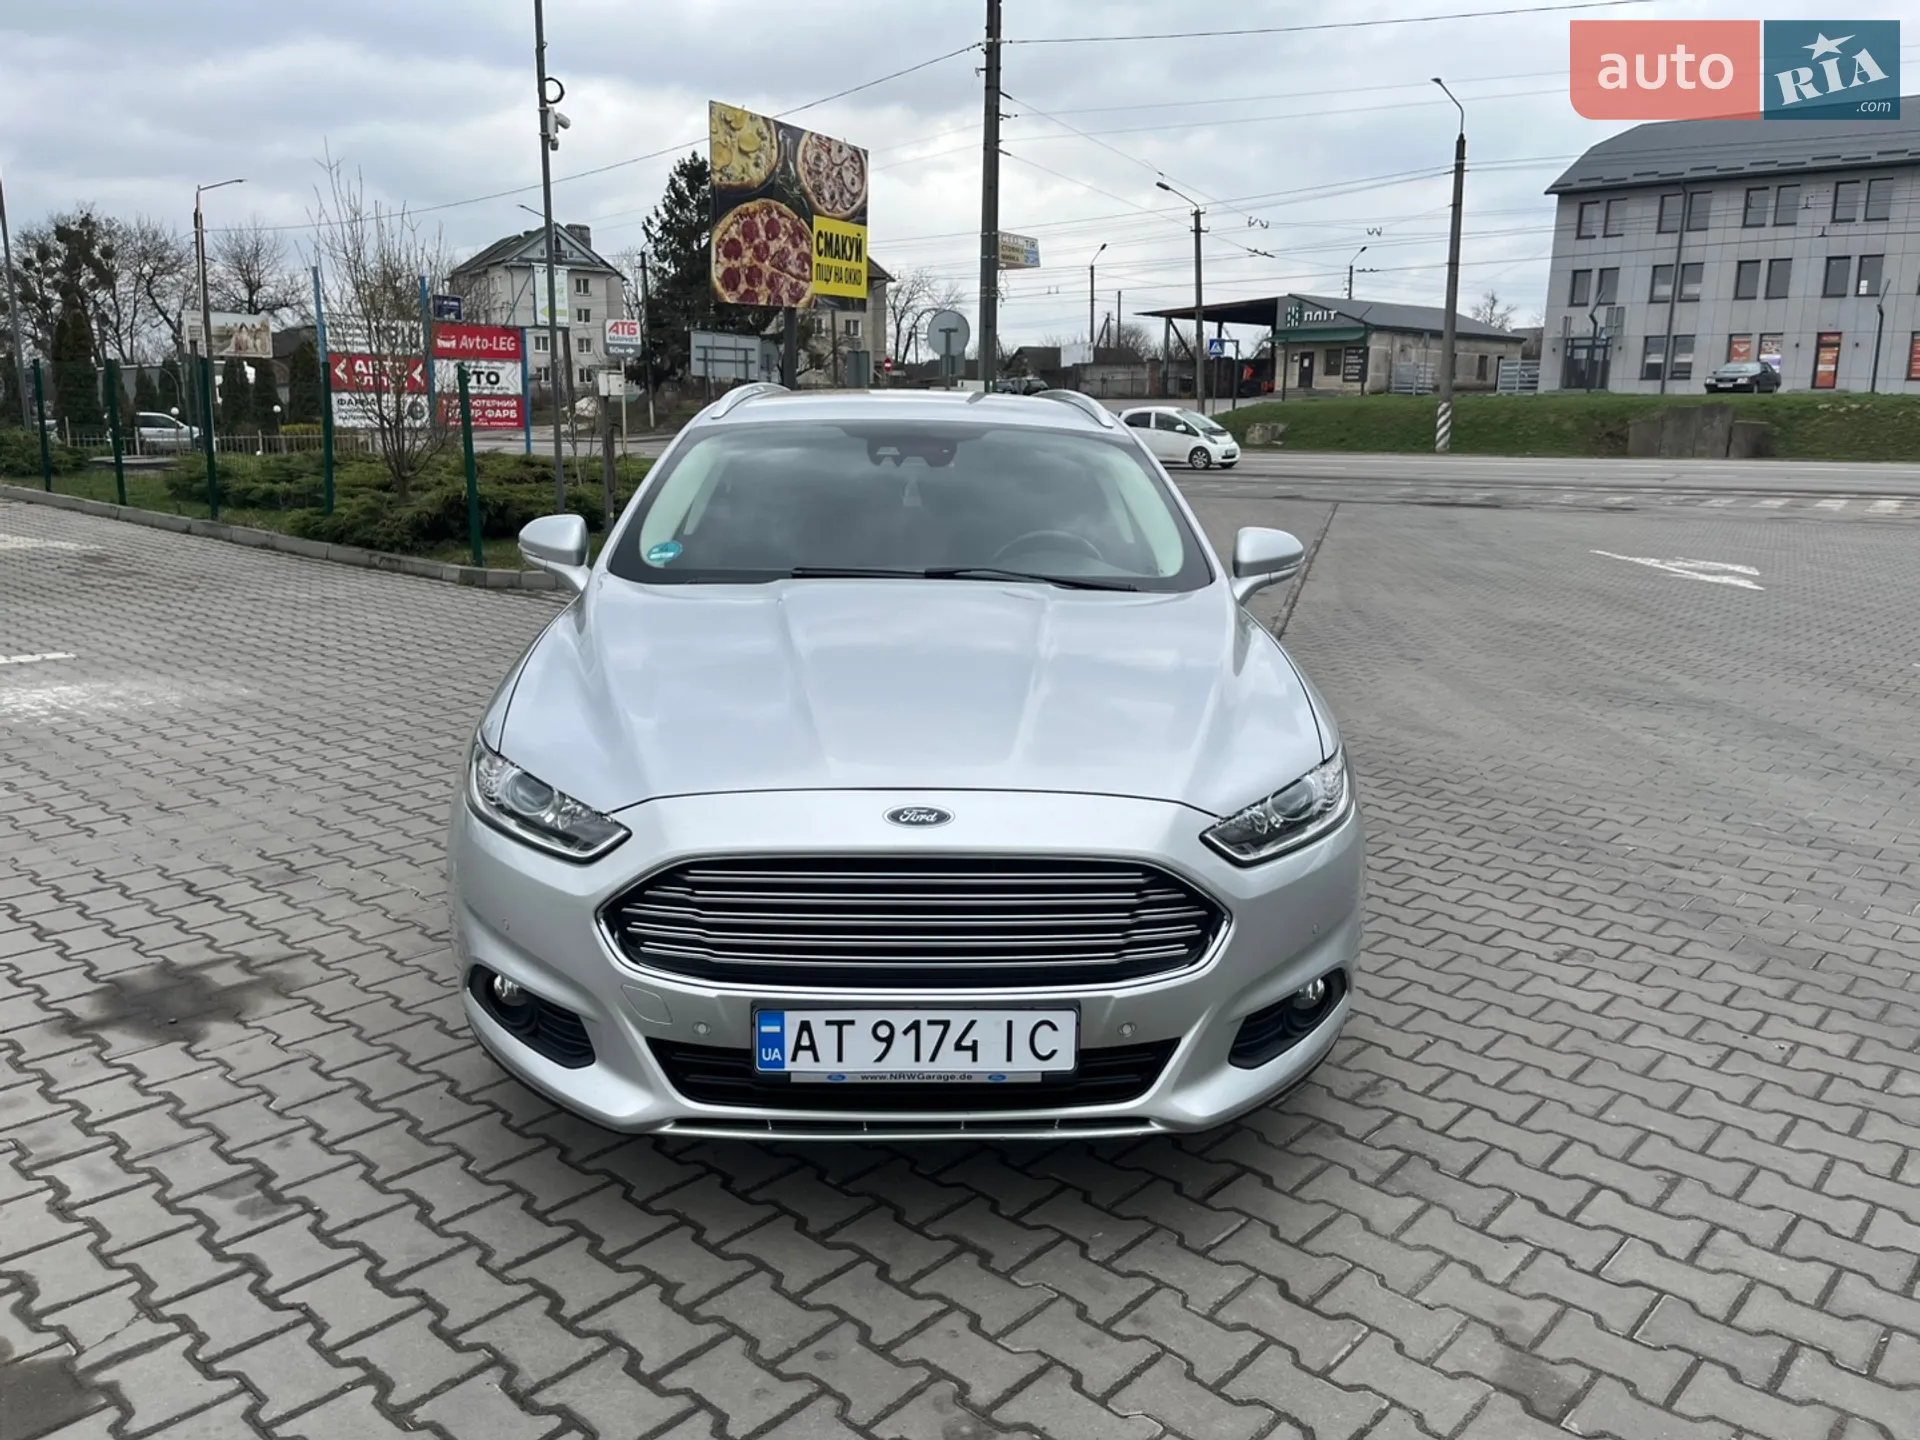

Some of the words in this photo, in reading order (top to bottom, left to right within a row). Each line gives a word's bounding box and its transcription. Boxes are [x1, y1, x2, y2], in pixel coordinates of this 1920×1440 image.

[816, 229, 862, 263] СМАКУЙ
[1304, 310, 1338, 322] ПЛІТ
[608, 321, 637, 336] АТБ
[459, 335, 515, 351] Avto-LEG
[899, 809, 938, 822] Ford
[790, 1019, 856, 1063] AT
[871, 1019, 979, 1063] 9174
[1006, 1019, 1059, 1063] IC
[762, 1048, 782, 1061] UA
[860, 1072, 973, 1082] www.NRWGarage.de
